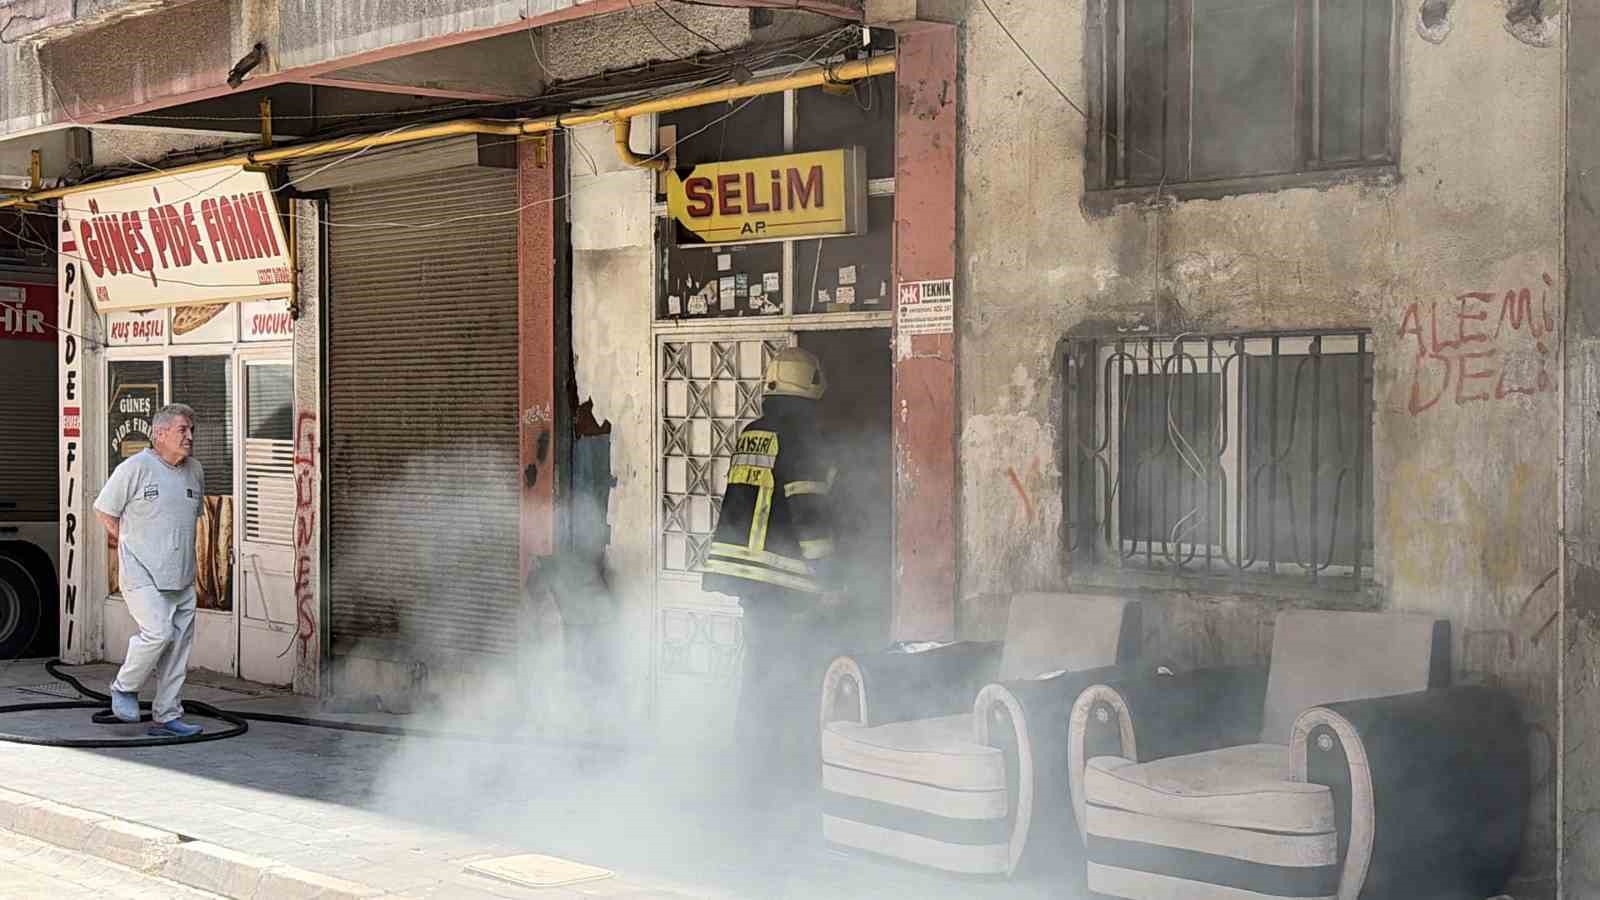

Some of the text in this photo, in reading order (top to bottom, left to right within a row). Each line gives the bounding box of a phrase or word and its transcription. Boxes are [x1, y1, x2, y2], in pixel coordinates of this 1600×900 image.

[80, 186, 281, 287] GÜNEŞ PİDE FIRINI
[65, 262, 76, 400] PİDE
[111, 319, 164, 342] KUŞ BAŞILI
[120, 394, 151, 417] GÜNEŞ
[133, 417, 154, 441] FIRI
[65, 442, 77, 650] FIRINI
